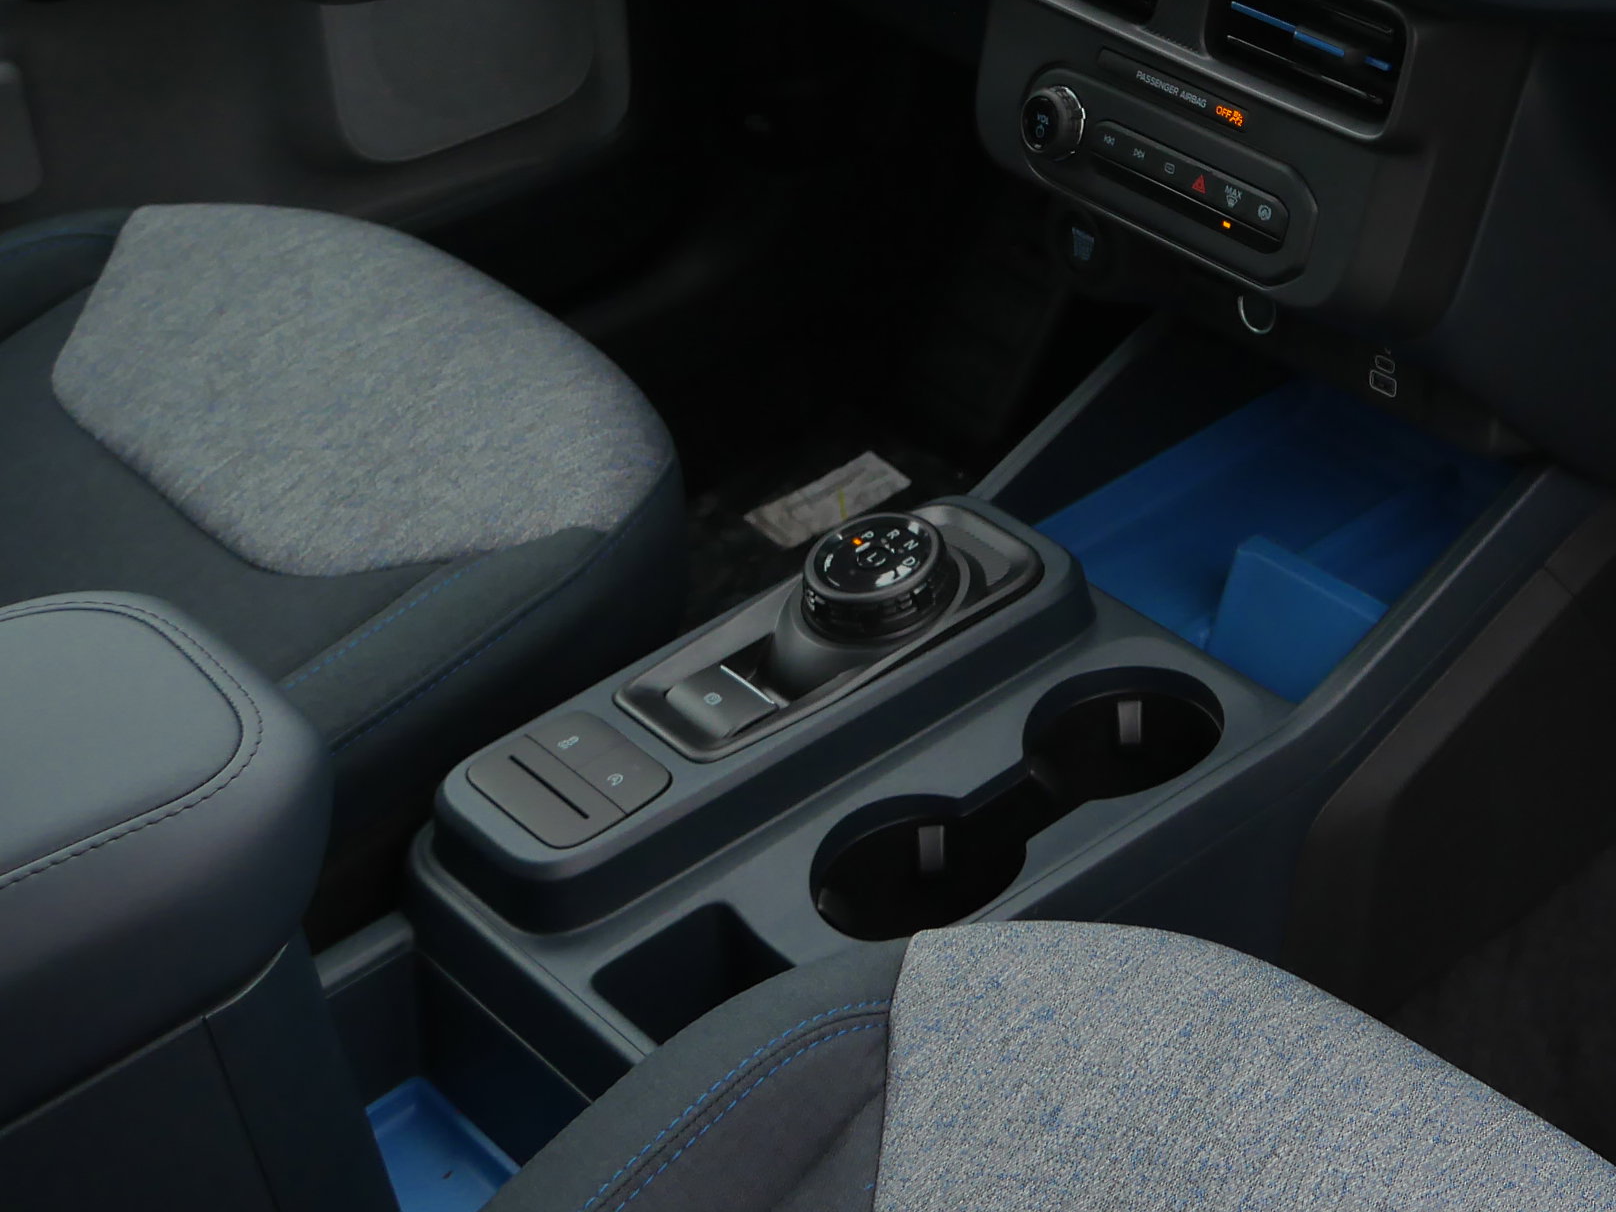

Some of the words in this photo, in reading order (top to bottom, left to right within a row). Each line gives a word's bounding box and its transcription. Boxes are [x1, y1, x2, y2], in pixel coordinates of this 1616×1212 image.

[1136, 70, 1179, 96] PASSENGER
[1180, 90, 1207, 108] AIRBAG
[1215, 105, 1232, 119] OFF
[1224, 184, 1242, 199] MAX
[861, 531, 874, 539] P
[887, 529, 900, 540] R
[904, 539, 919, 550] N
[866, 552, 877, 563] L
[902, 556, 916, 566] D
